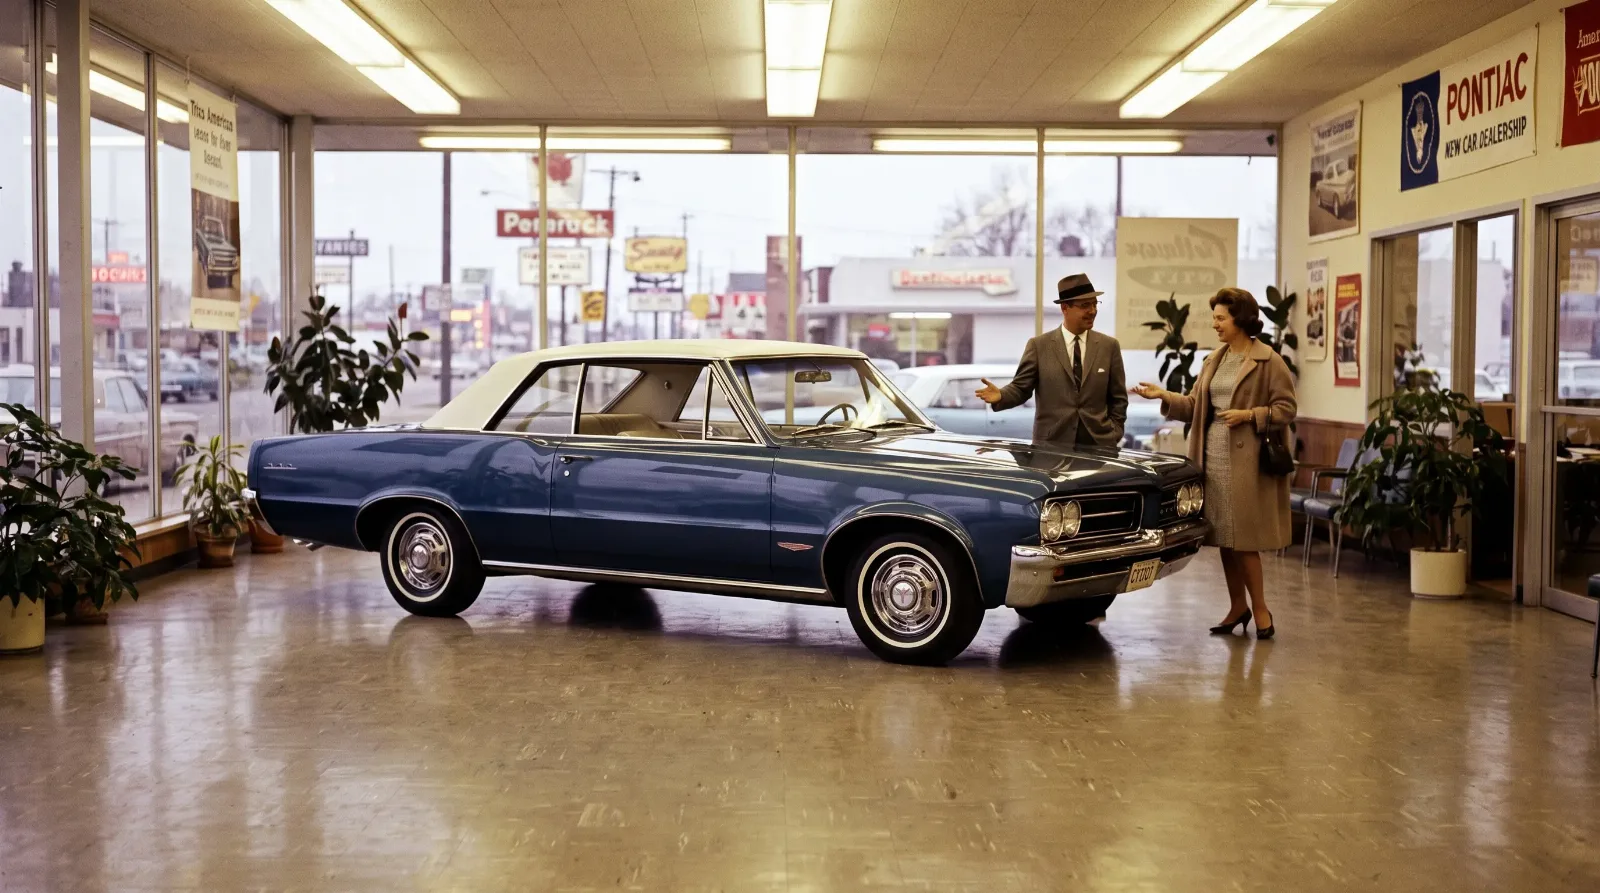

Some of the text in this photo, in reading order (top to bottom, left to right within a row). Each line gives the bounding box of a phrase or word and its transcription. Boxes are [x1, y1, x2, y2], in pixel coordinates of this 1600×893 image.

[1446, 52, 1529, 126] PONTIAC
[1444, 115, 1527, 159] NEW CAR DEALERSHIP
